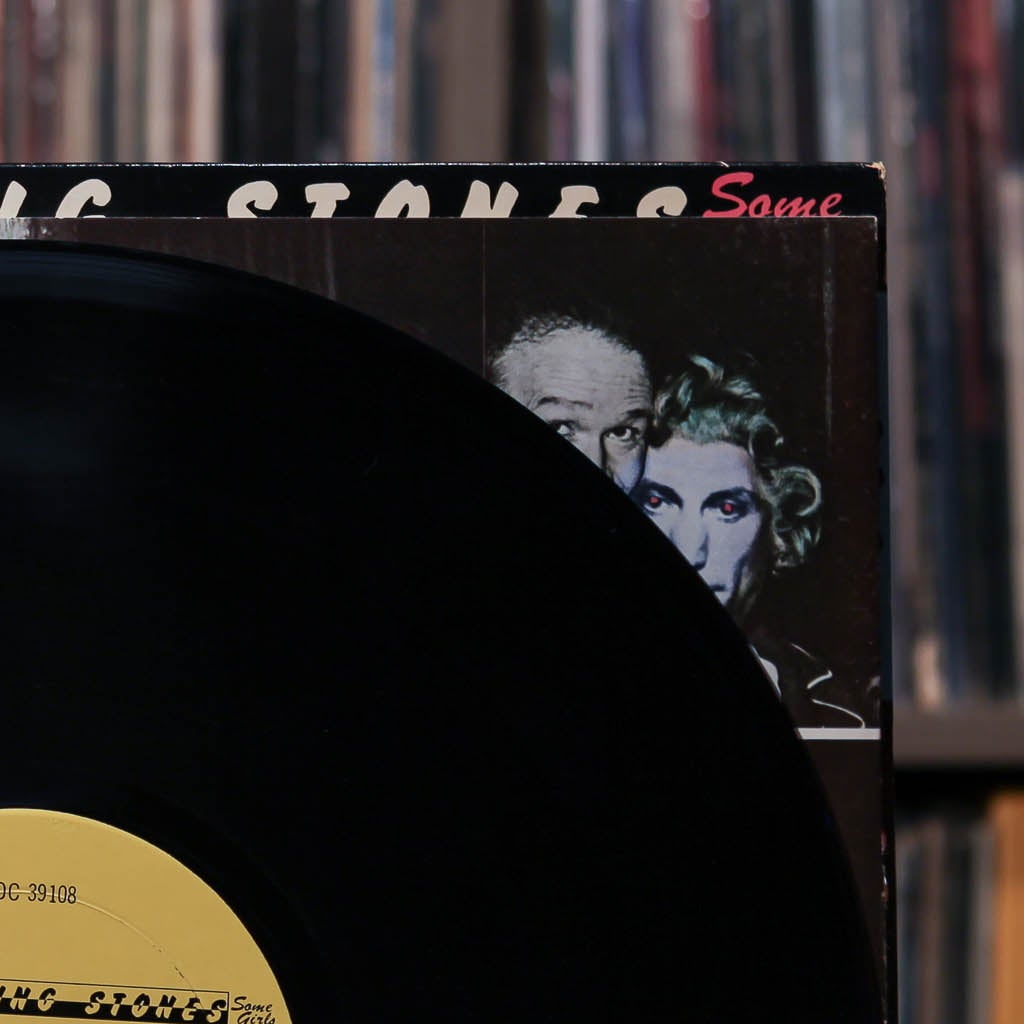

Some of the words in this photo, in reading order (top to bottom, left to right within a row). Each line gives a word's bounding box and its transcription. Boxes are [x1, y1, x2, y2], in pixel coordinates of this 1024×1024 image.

[702, 172, 843, 218] Some
[28, 883, 77, 904] 39108
[84, 990, 228, 1023] STONES
[231, 996, 273, 1012] Some
